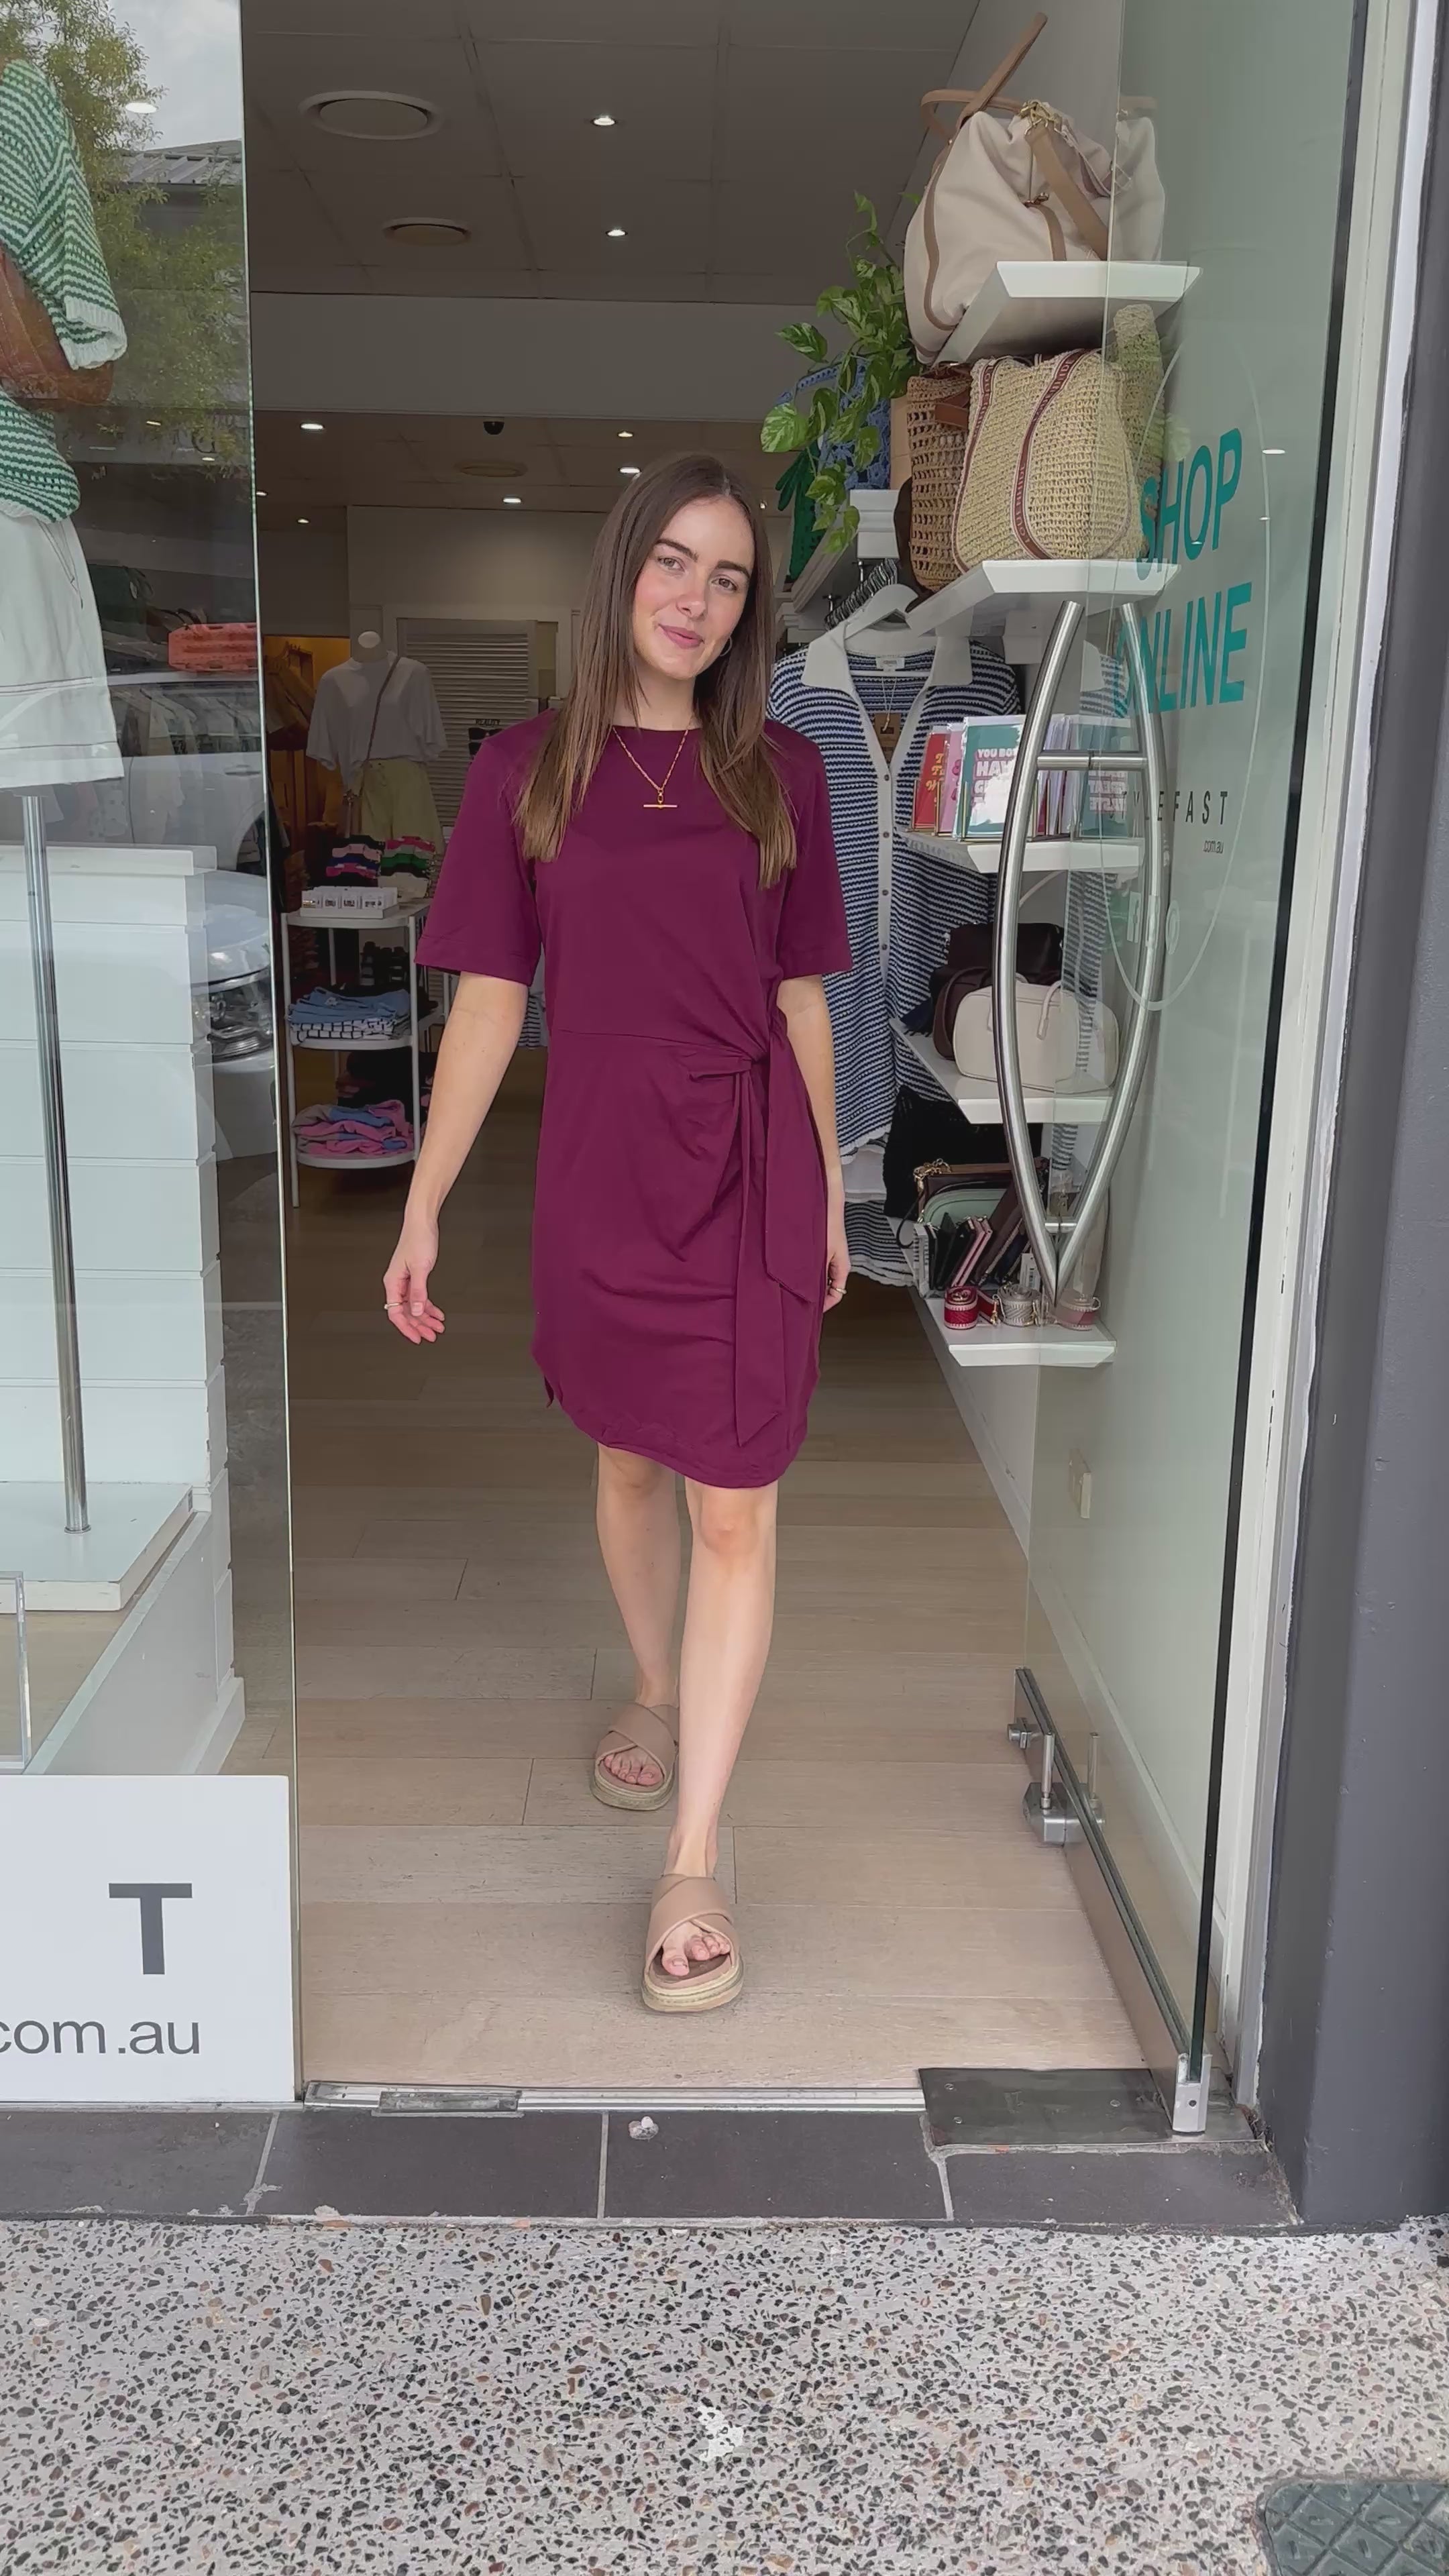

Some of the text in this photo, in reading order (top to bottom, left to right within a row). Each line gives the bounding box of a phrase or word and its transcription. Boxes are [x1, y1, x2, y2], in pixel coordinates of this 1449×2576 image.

[1136, 428, 1242, 581] SHOP
[1114, 582, 1252, 718] ONLINE
[977, 748, 998, 758] YOU
[1110, 790, 1228, 824] STYEFAST
[109, 1883, 193, 1975] T
